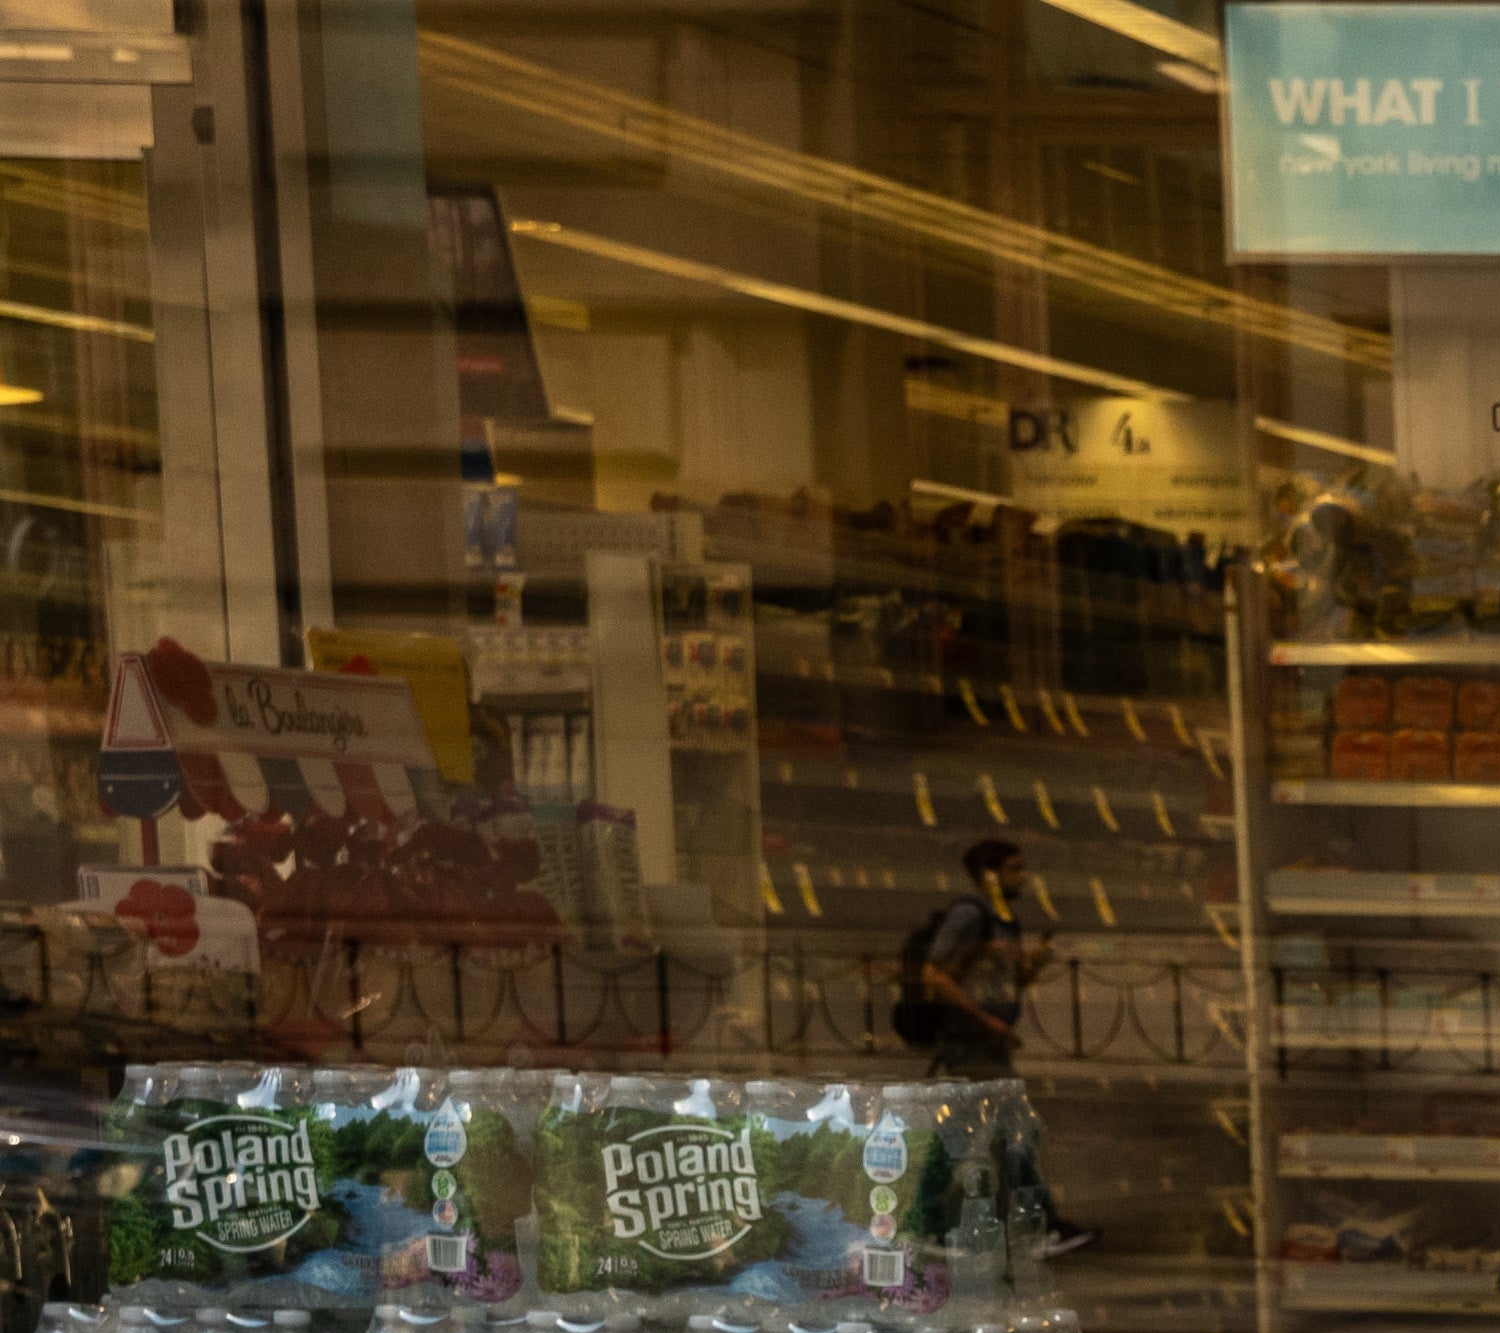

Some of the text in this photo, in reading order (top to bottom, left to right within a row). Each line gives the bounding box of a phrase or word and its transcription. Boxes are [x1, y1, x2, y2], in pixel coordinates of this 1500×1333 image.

[1270, 77, 1444, 126] WHAT
[1463, 79, 1482, 126] I
[163, 1118, 315, 1184] Poland
[601, 1128, 757, 1196] Poland
[165, 1164, 321, 1229] Spring
[216, 1212, 293, 1242] SPRING WATER
[606, 1174, 764, 1239] Spring
[659, 1220, 733, 1251] SPRING WATER
